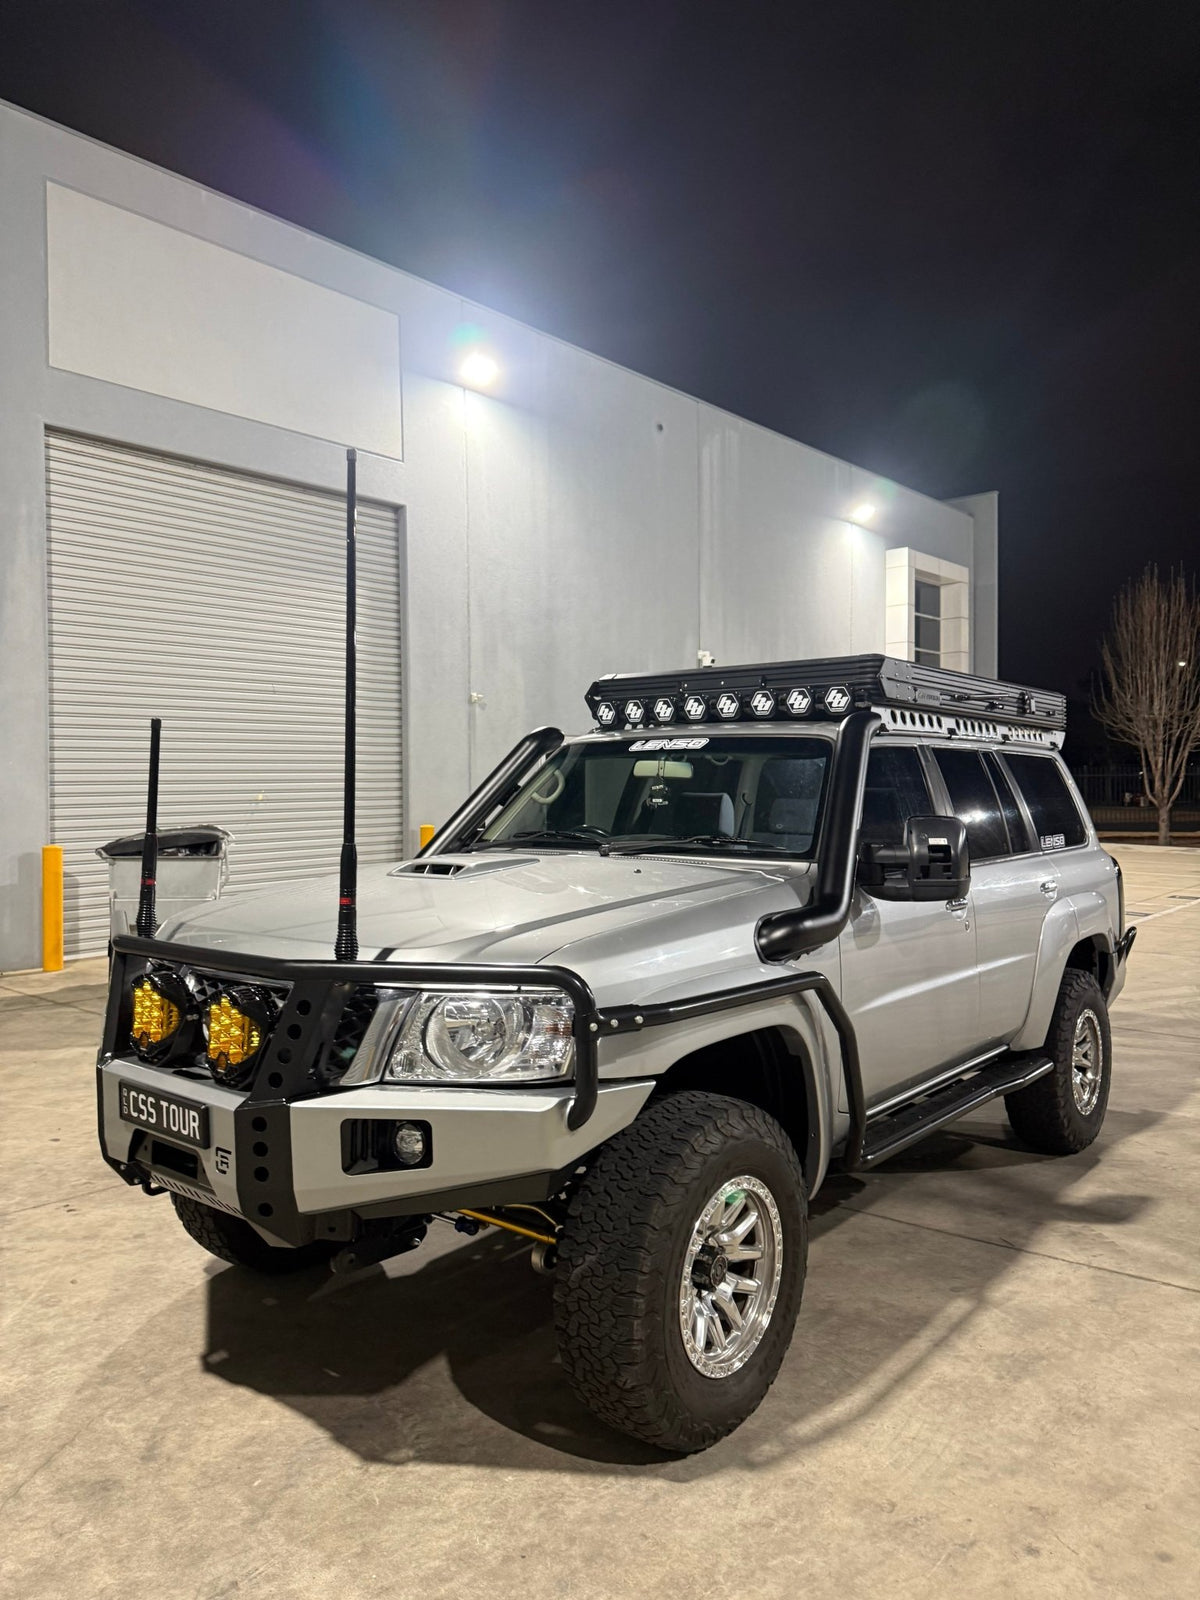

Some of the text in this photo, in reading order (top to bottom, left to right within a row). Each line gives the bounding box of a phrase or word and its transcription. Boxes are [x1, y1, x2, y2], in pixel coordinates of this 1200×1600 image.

[629, 738, 709, 751] LENSO
[129, 1091, 200, 1140] CSS TOUR
